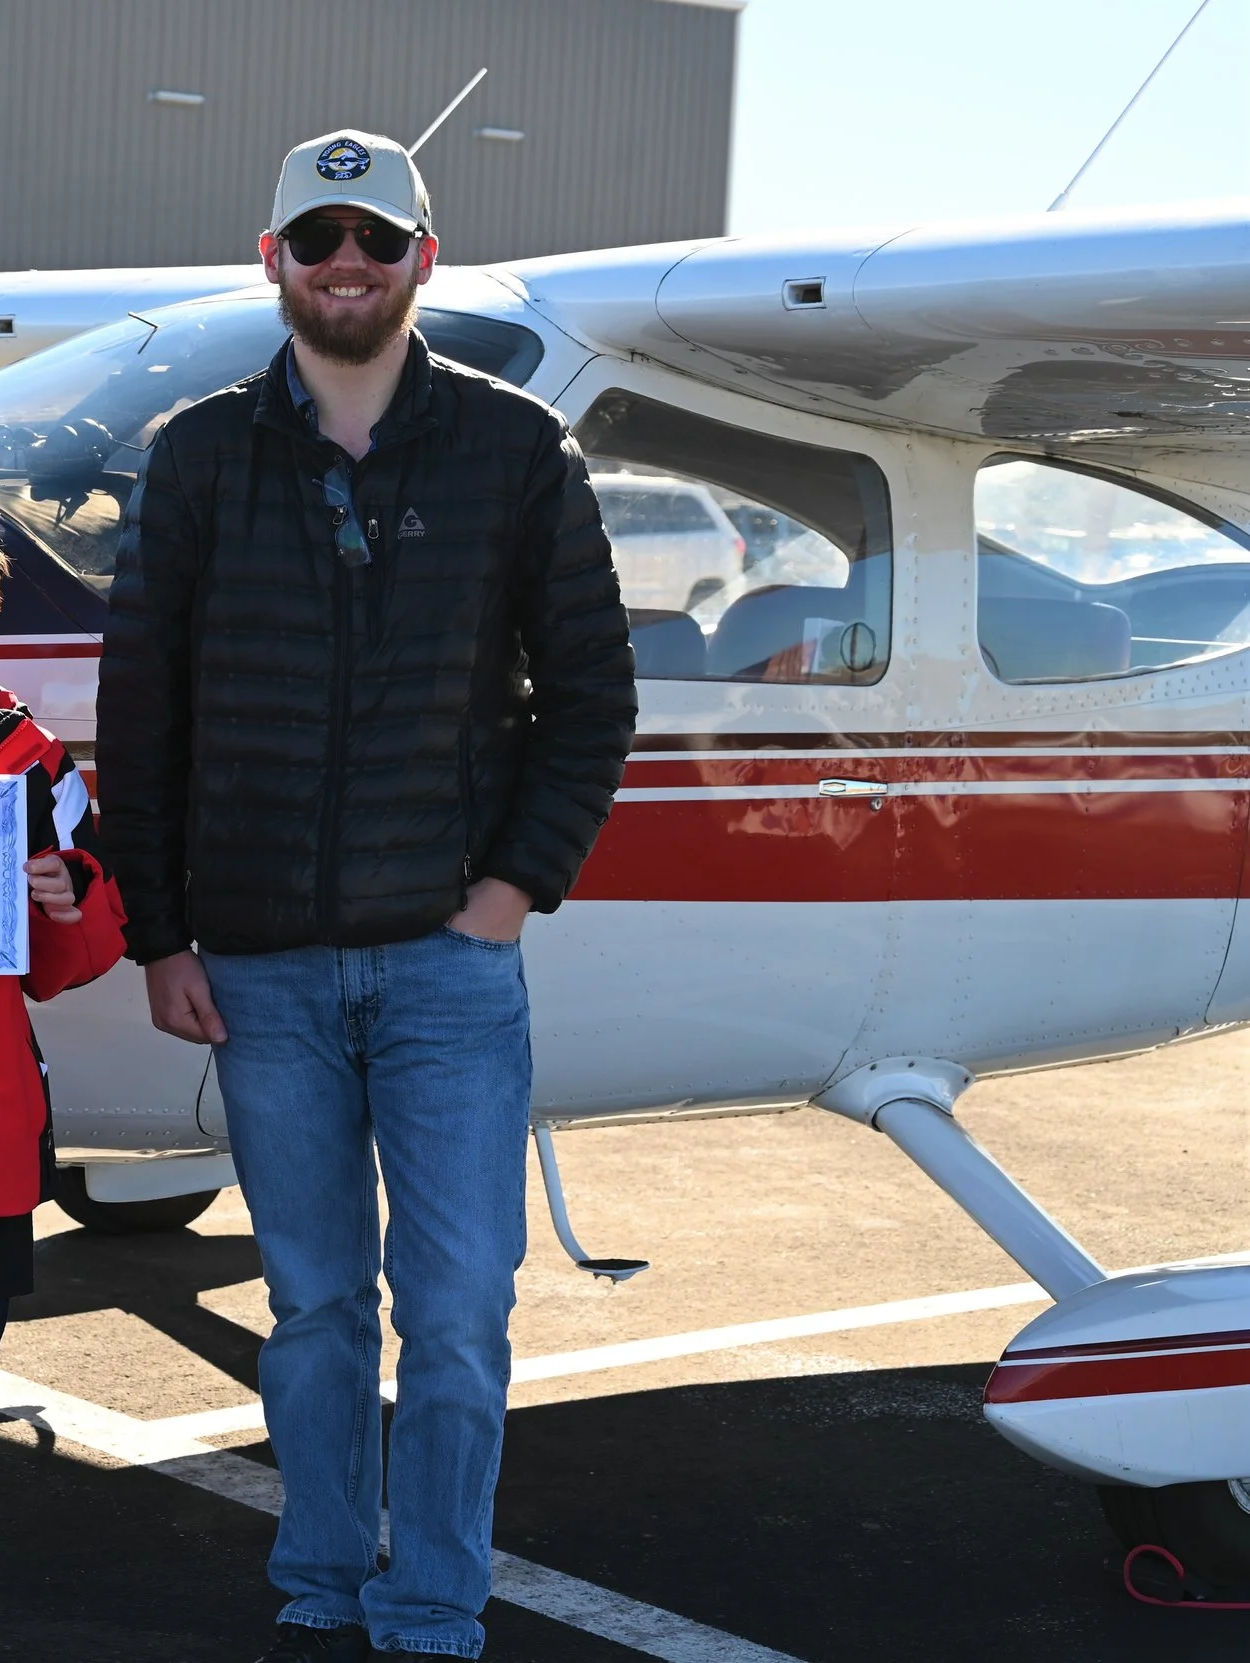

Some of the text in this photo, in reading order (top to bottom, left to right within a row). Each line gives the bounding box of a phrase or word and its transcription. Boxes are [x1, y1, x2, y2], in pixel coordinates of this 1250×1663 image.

[322, 141, 366, 157] YOUNG EAGLES
[397, 530, 426, 540] GERRY
